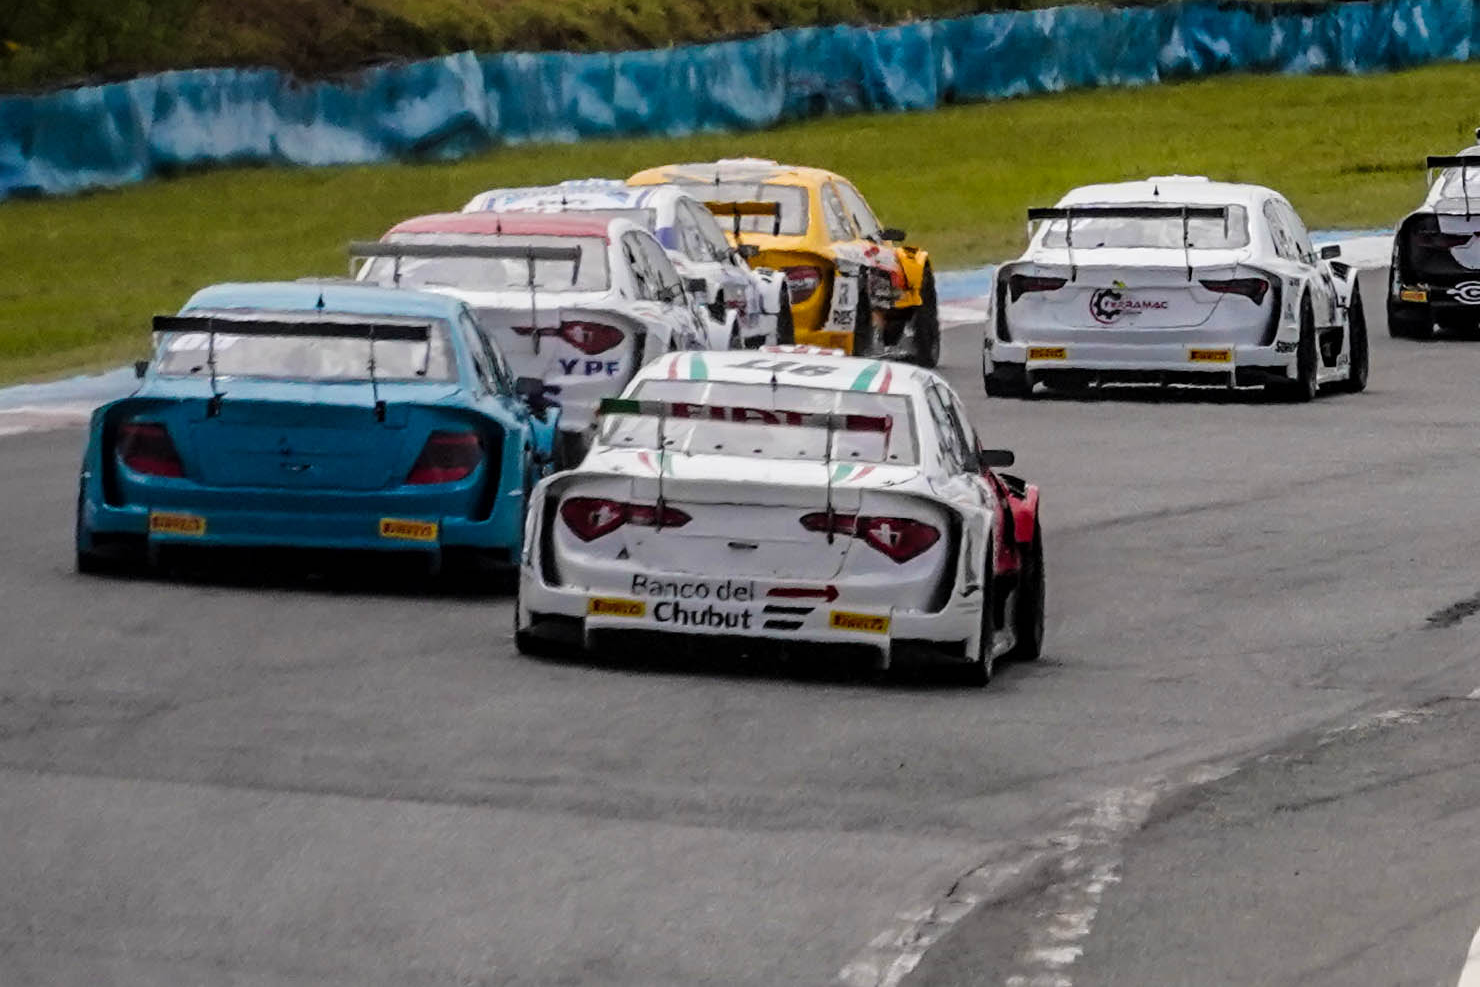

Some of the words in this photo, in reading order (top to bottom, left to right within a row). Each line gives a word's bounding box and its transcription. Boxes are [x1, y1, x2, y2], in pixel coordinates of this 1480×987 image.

[559, 359, 620, 375] YPF
[672, 402, 813, 426] FIAT
[631, 574, 710, 600] Banco
[716, 580, 755, 602] del
[653, 600, 752, 630] Chubut
